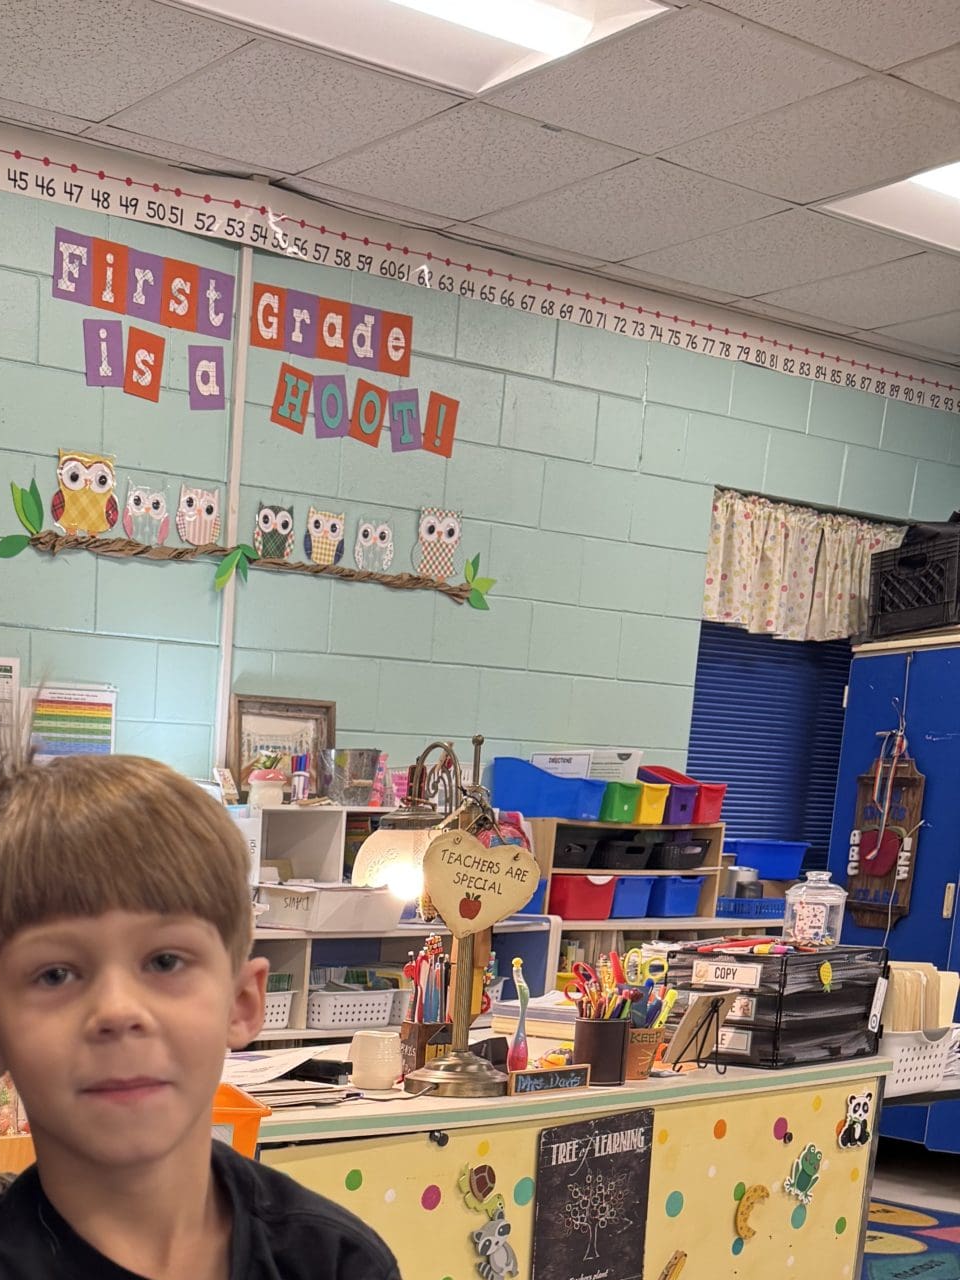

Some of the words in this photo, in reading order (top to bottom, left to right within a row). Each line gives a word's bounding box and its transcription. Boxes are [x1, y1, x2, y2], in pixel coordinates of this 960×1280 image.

[7, 167, 29, 191] 45
[35, 174, 56, 197] 46
[64, 180, 83, 203] 47
[91, 187, 111, 209] 48
[119, 195, 139, 215] 49
[145, 200, 166, 221] 50
[168, 206, 184, 226] 51
[194, 212, 216, 232] 52
[224, 218, 245, 238] 53
[250, 224, 268, 244] 54
[293, 237, 308, 257] 56
[312, 243, 330, 263] 57
[334, 248, 351, 268] 58
[356, 254, 373, 273] 59
[379, 259, 397, 278] 60
[397, 264, 411, 282] 61
[438, 274, 454, 293] 63
[459, 279, 475, 298] 64
[480, 284, 496, 302] 65
[500, 289, 515, 307] 66
[520, 294, 536, 312] 67
[540, 299, 555, 316] 68
[559, 303, 574, 320] 69
[578, 307, 593, 324] 70
[596, 311, 607, 329] 71
[613, 316, 627, 334] 72
[631, 320, 645, 337] 73
[649, 324, 663, 342] 74
[668, 329, 681, 346] 75
[685, 333, 698, 349] 76
[702, 337, 716, 354] 77
[719, 341, 731, 357] 78
[737, 345, 750, 361] 79
[755, 349, 766, 365] 80
[769, 353, 778, 369] 81
[782, 358, 795, 373] 82
[798, 362, 811, 377] 83
[815, 365, 827, 381] 84
[830, 369, 842, 384] 85
[845, 373, 856, 388] 86
[860, 376, 872, 391] 87
[875, 380, 886, 395] 88
[889, 384, 900, 398] 89
[904, 387, 914, 401] 90
[917, 391, 925, 404] 91
[930, 394, 940, 408] 92
[944, 397, 954, 411] 93
[57, 240, 227, 328] First
[256, 291, 407, 363] Grade
[98, 328, 155, 387] is
[195, 359, 220, 396] a
[278, 373, 448, 448] HOOT!
[441, 849, 500, 875] TEACHERS
[505, 866, 529, 883] ARE
[453, 872, 503, 895] SPECIAL
[714, 966, 738, 981] COPY
[630, 1031, 662, 1044] KEEP
[551, 1140, 579, 1166] TREE
[594, 1128, 645, 1157] LEARNING
